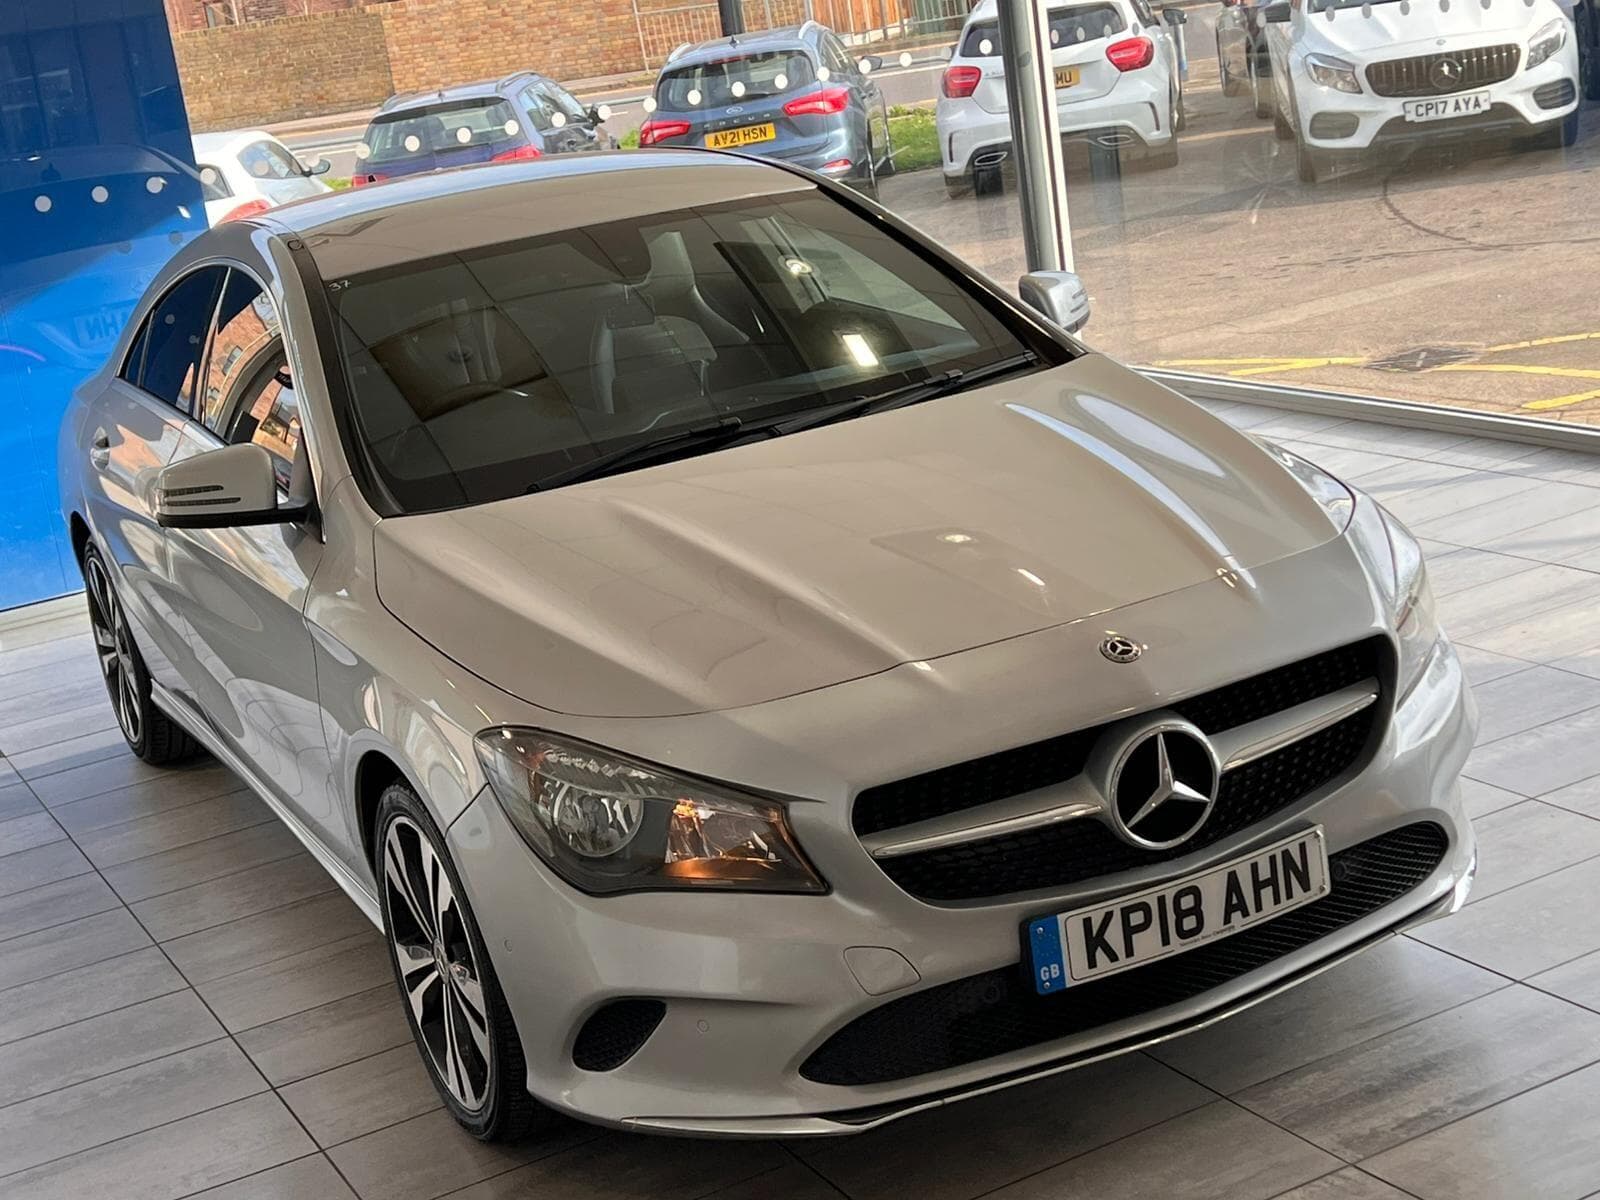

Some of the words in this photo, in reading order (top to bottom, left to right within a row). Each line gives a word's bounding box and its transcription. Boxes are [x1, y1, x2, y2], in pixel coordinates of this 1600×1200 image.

[1054, 71, 1073, 85] MU
[1415, 100, 1448, 117] CP17
[1453, 95, 1482, 113] AYA
[713, 131, 741, 147] AV21
[742, 126, 767, 141] HSN
[1082, 884, 1206, 970] KP18
[1223, 841, 1312, 926] AHN
[1040, 963, 1061, 981] GB
